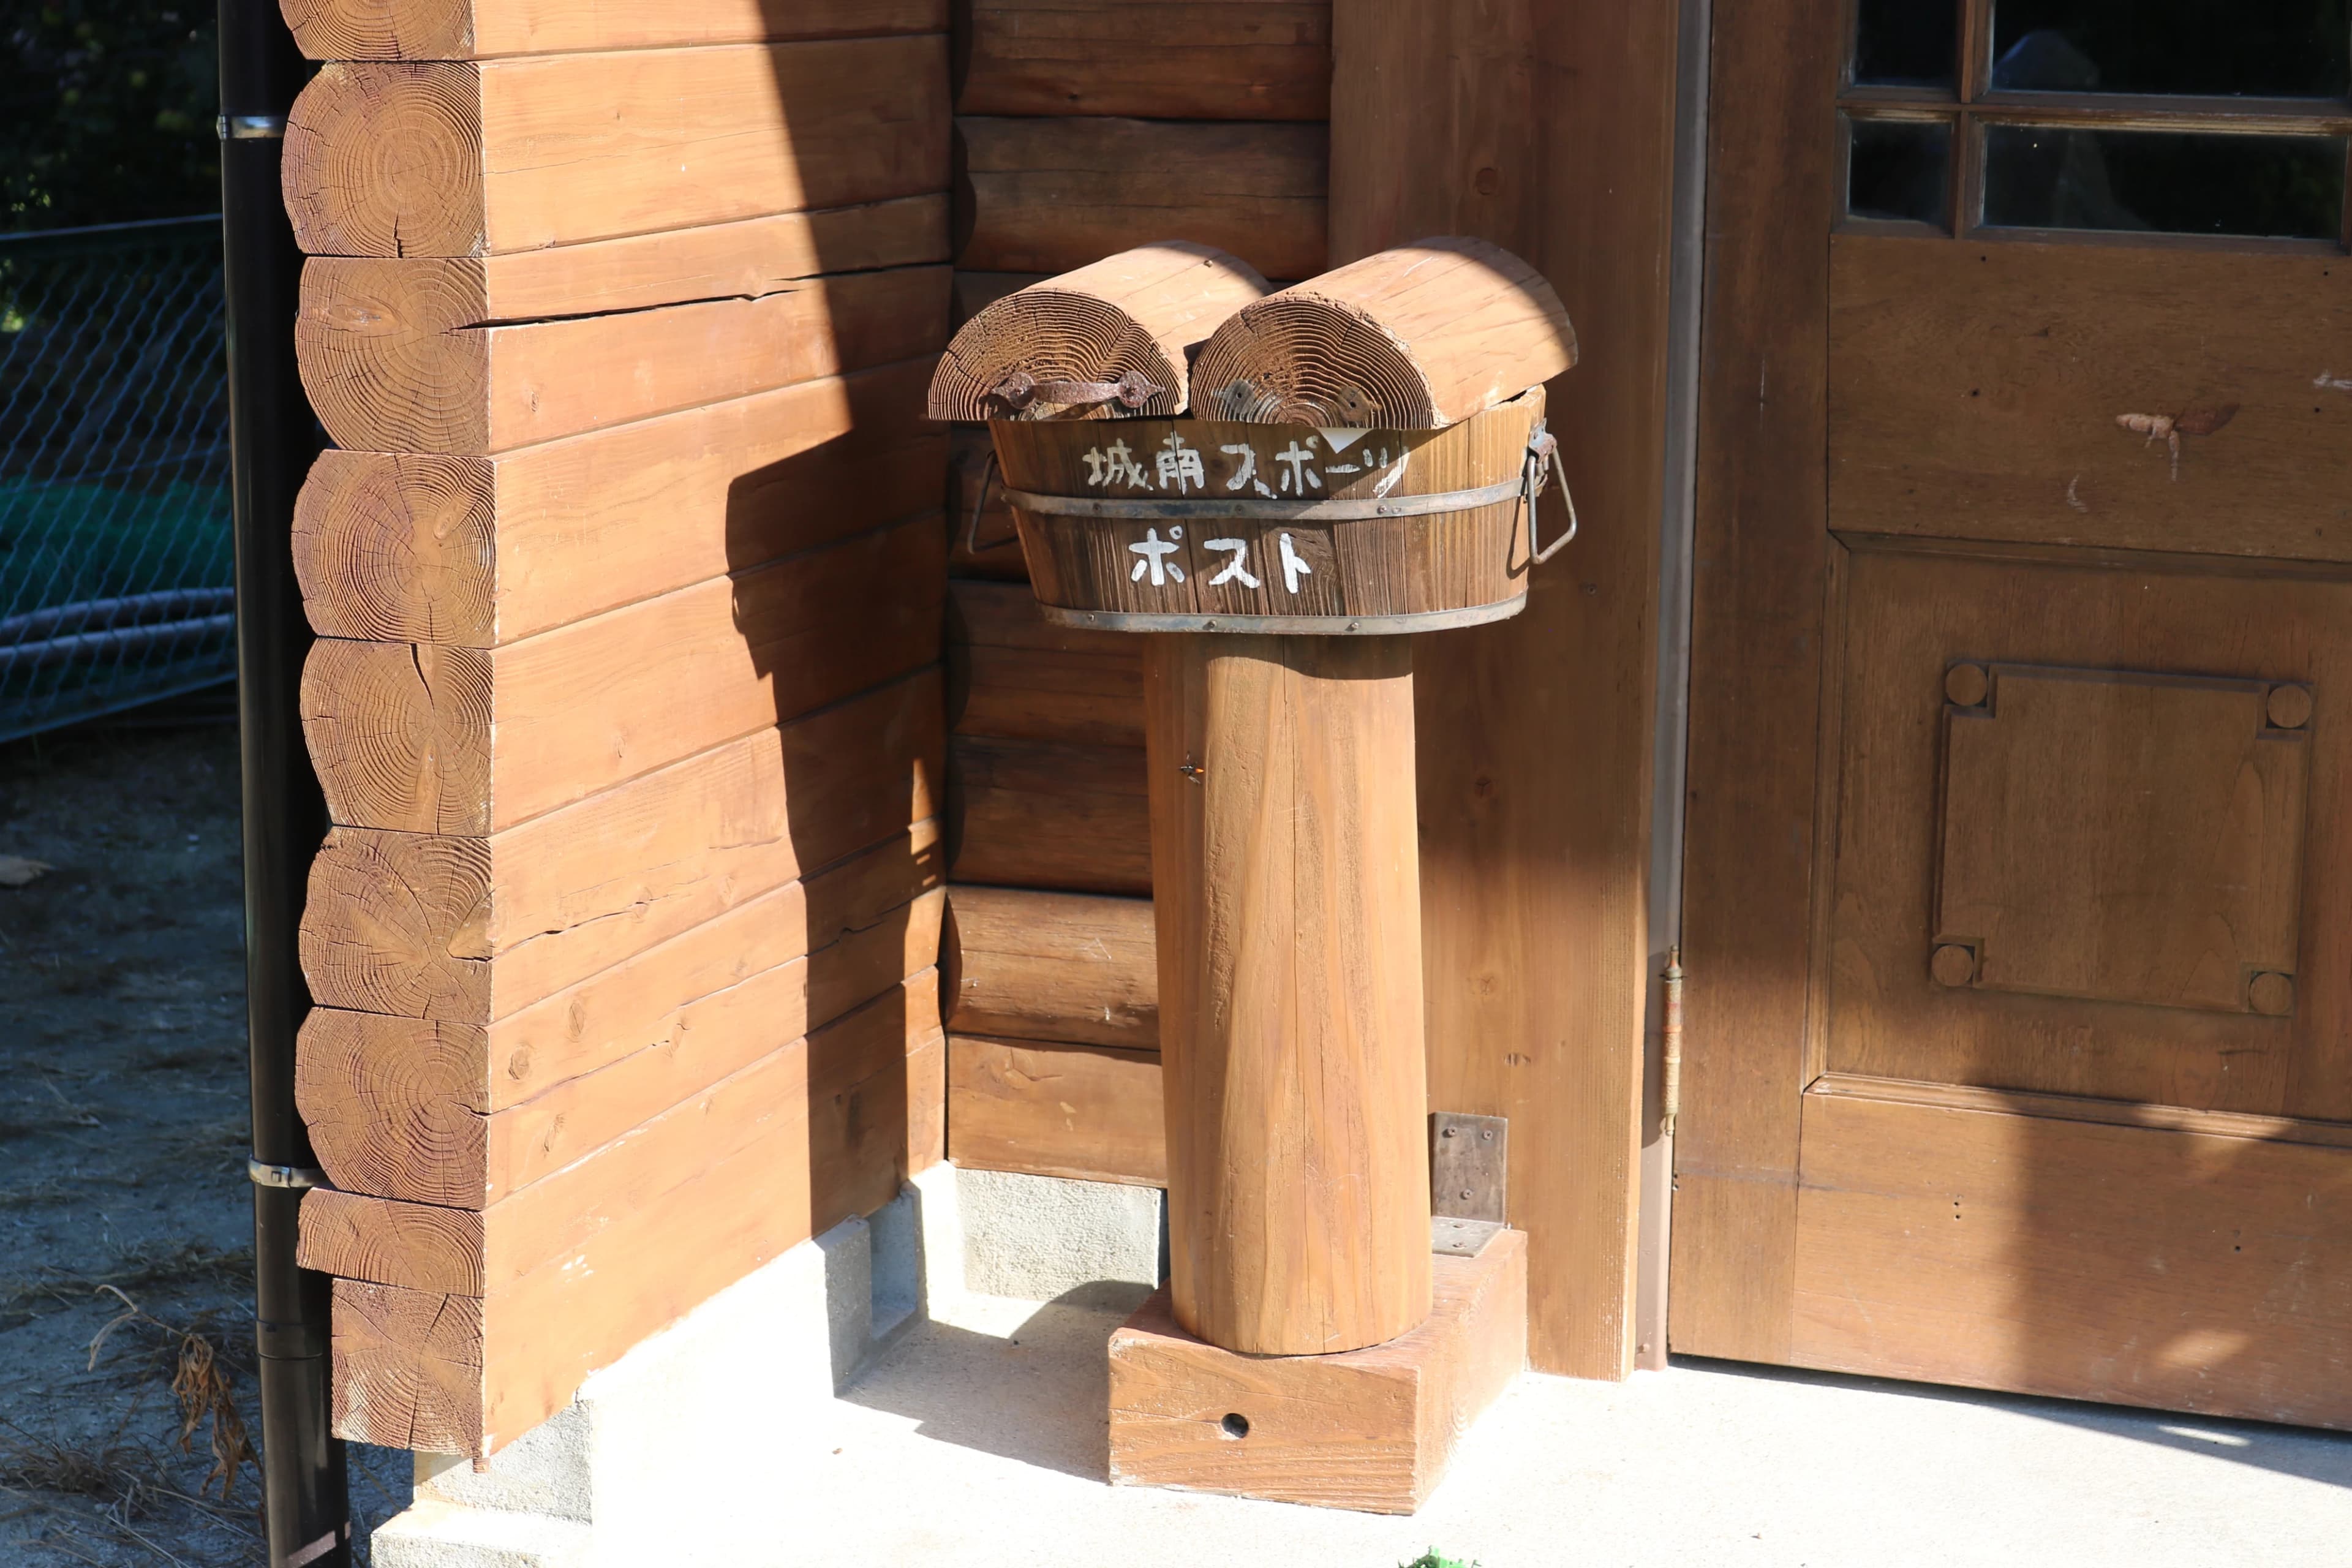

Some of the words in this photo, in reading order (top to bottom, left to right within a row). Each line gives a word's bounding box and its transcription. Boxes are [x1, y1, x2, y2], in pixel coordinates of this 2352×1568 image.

[1082, 432, 1410, 499] 城南スポーツ
[1129, 526, 1311, 594] ポスト
